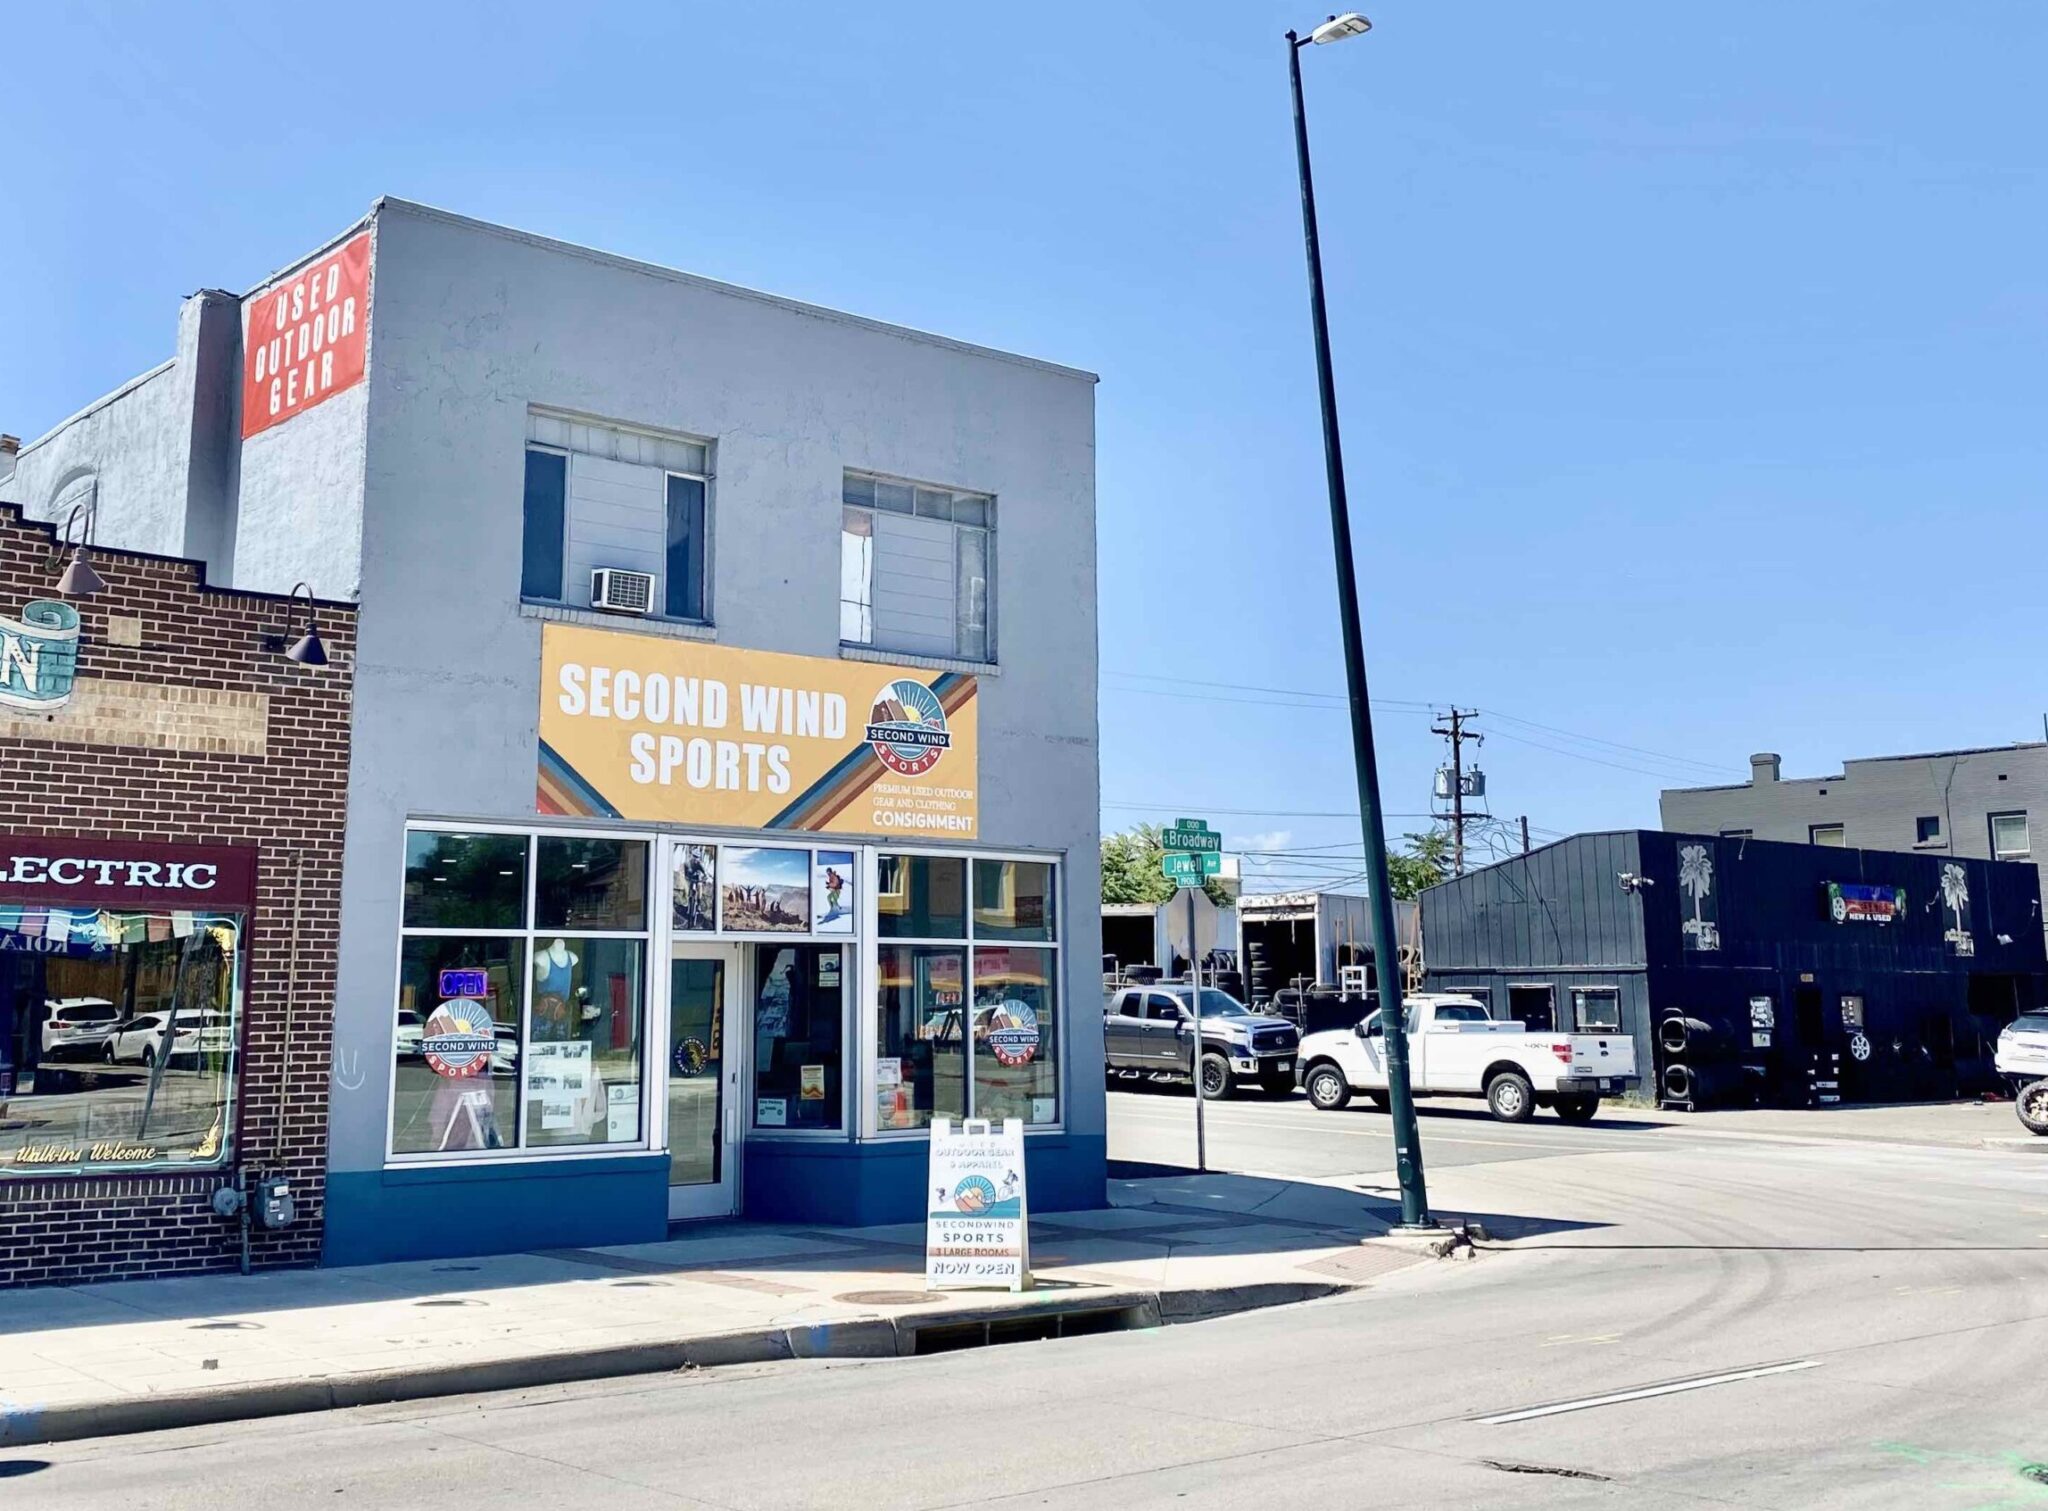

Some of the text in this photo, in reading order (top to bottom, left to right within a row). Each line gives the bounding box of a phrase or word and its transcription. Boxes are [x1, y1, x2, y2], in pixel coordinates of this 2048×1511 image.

[276, 263, 339, 331] USED
[255, 296, 355, 383] OUTDOOR
[270, 350, 333, 416] GEAR
[559, 663, 847, 740] SECOND WIND
[870, 729, 946, 745] SECOND WIND
[630, 732, 790, 794] SPORTS
[878, 744, 938, 772] SPORTS
[873, 783, 974, 800] PREMIUM USED OUTDOOR
[873, 796, 956, 811] GEAR AND CLOTHING
[873, 811, 973, 832] CONSIGNMENT
[1169, 831, 1219, 851] Broadway
[0, 857, 217, 889] ECTRIC
[1171, 856, 1202, 873] Jewell
[1872, 914, 1891, 922] USED
[442, 973, 484, 994] OPEN
[422, 1042, 495, 1051] SECOND WIND
[994, 1046, 1034, 1064] SPORTS
[429, 1054, 488, 1077] SPORTS
[90, 1141, 156, 1161] Welcome
[936, 1221, 1014, 1229] SECONDWIND
[943, 1233, 1004, 1243] SPORTS
[936, 1248, 1009, 1257] 3 LARGE ROOMS
[934, 1262, 1014, 1275] NOW OPEN
